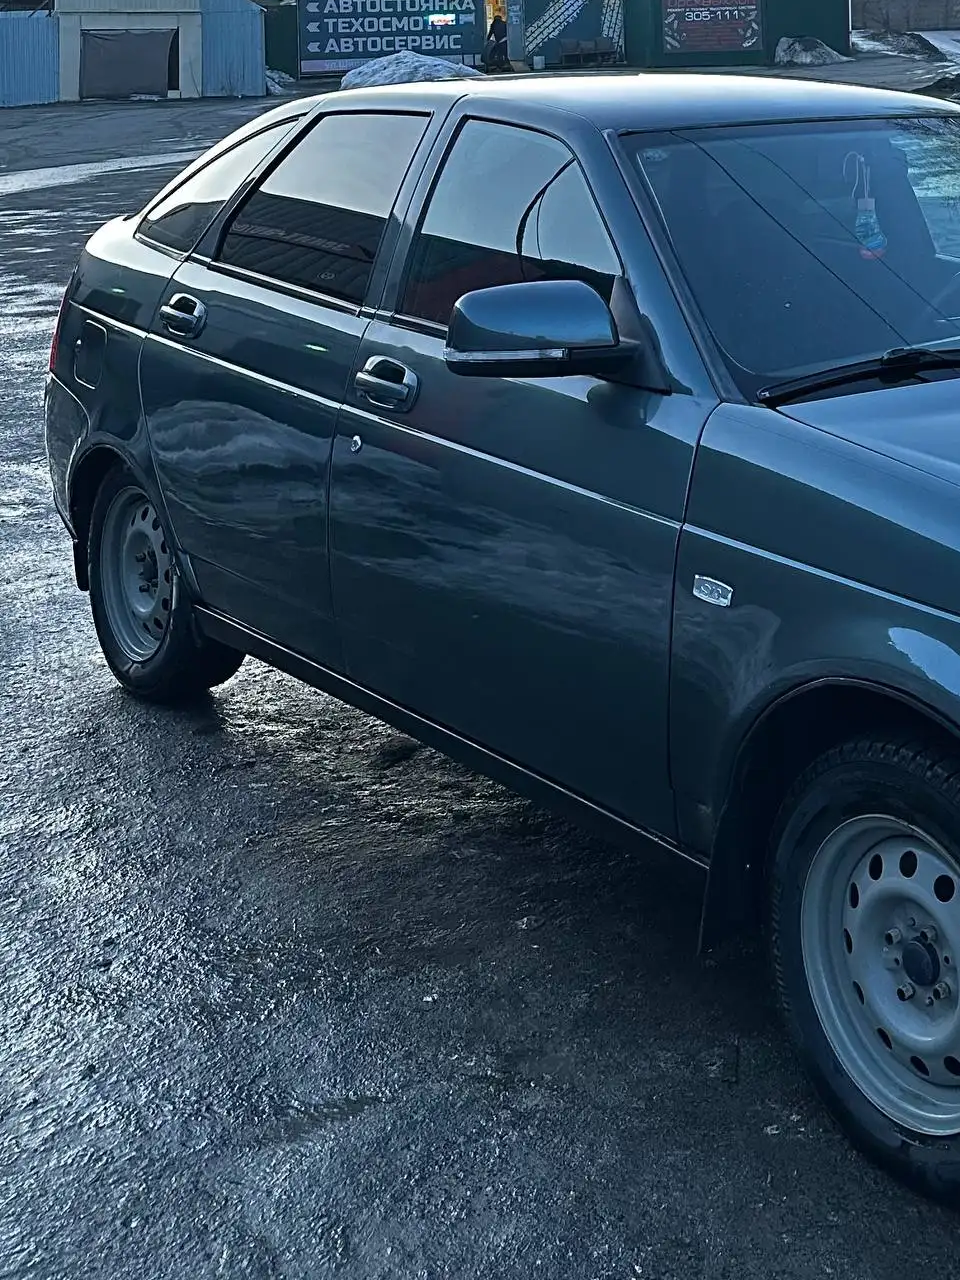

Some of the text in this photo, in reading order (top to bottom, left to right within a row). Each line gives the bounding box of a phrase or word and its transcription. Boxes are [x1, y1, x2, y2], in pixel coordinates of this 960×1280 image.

[324, 15, 447, 33] ТЕХОСМО
[685, 10, 739, 21] 305-111
[324, 35, 462, 53] АВТОСЕРВИС
